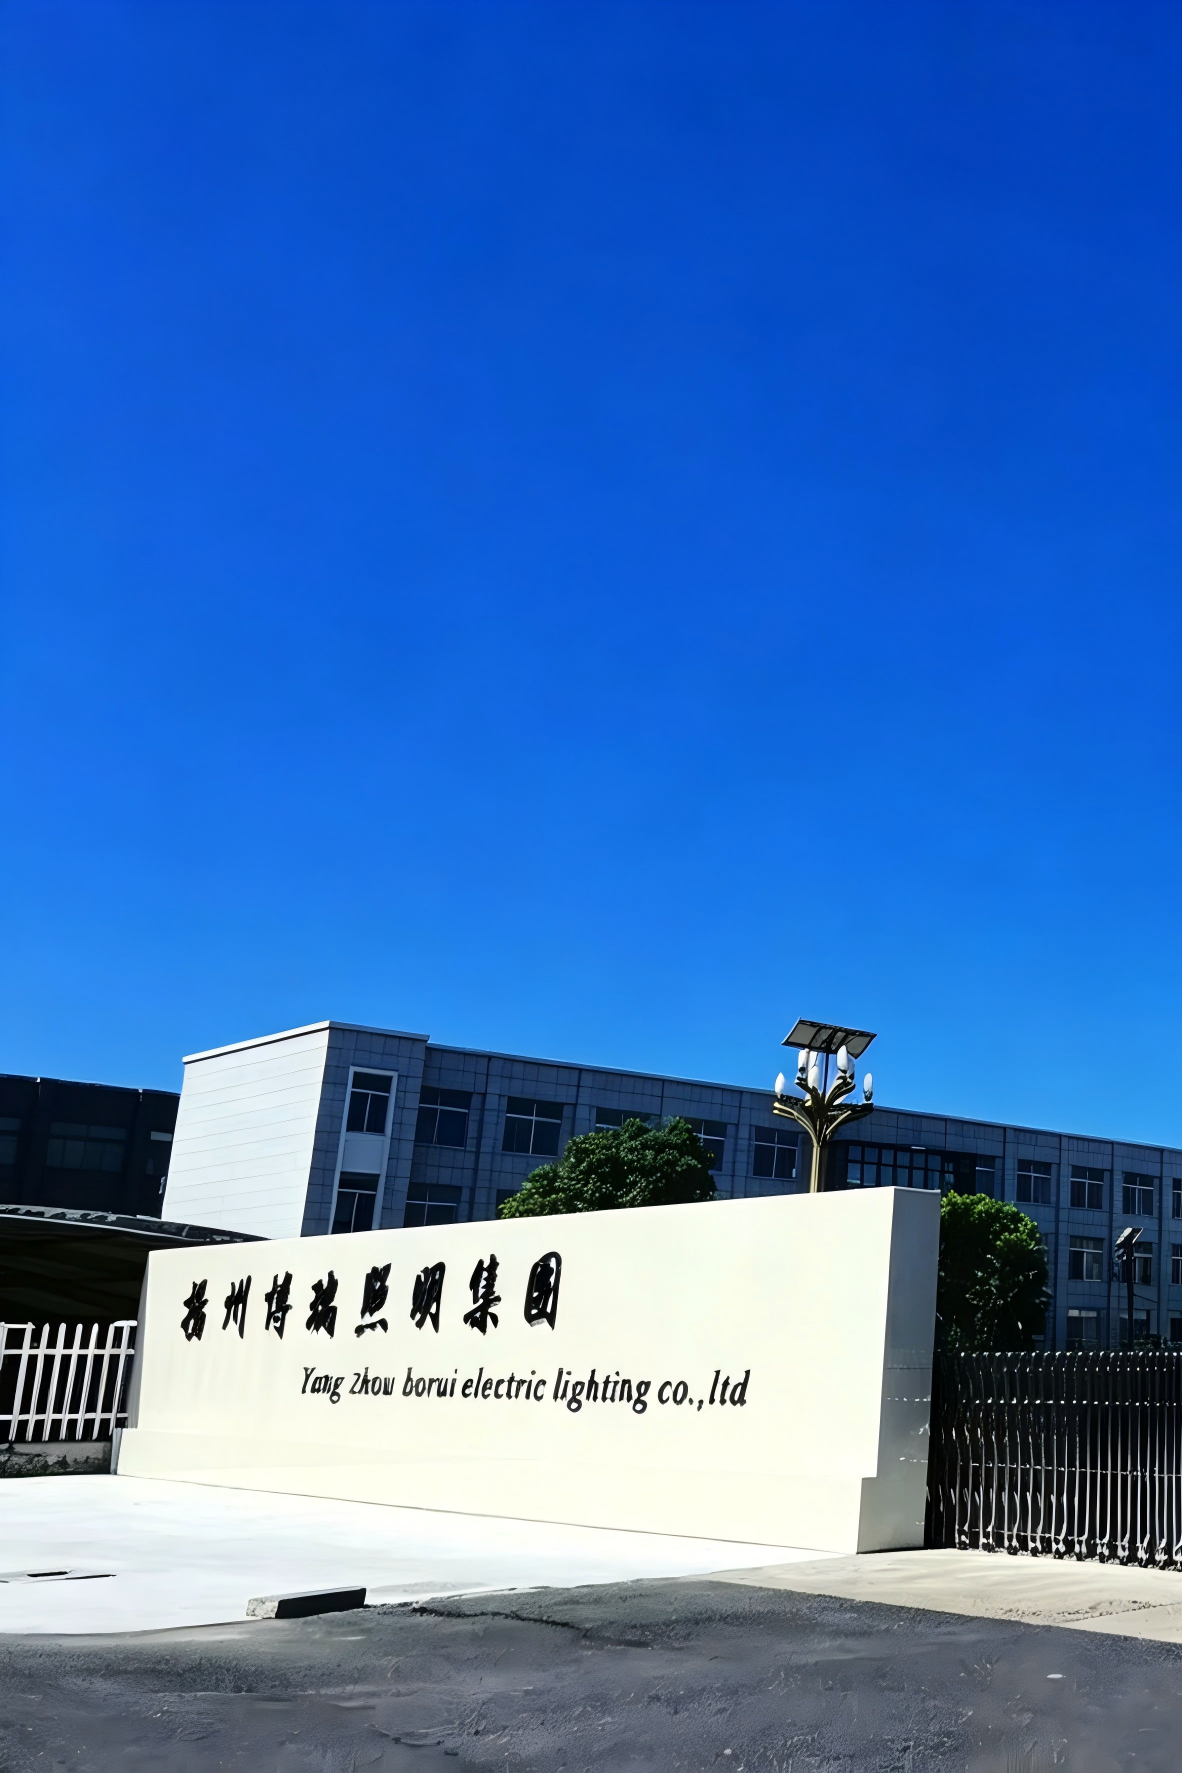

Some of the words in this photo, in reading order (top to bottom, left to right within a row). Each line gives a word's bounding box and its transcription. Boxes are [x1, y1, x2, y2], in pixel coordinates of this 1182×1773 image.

[301, 1366, 346, 1405] Yang
[401, 1367, 458, 1398] borui
[461, 1367, 547, 1402] electric
[552, 1367, 652, 1415] lighting
